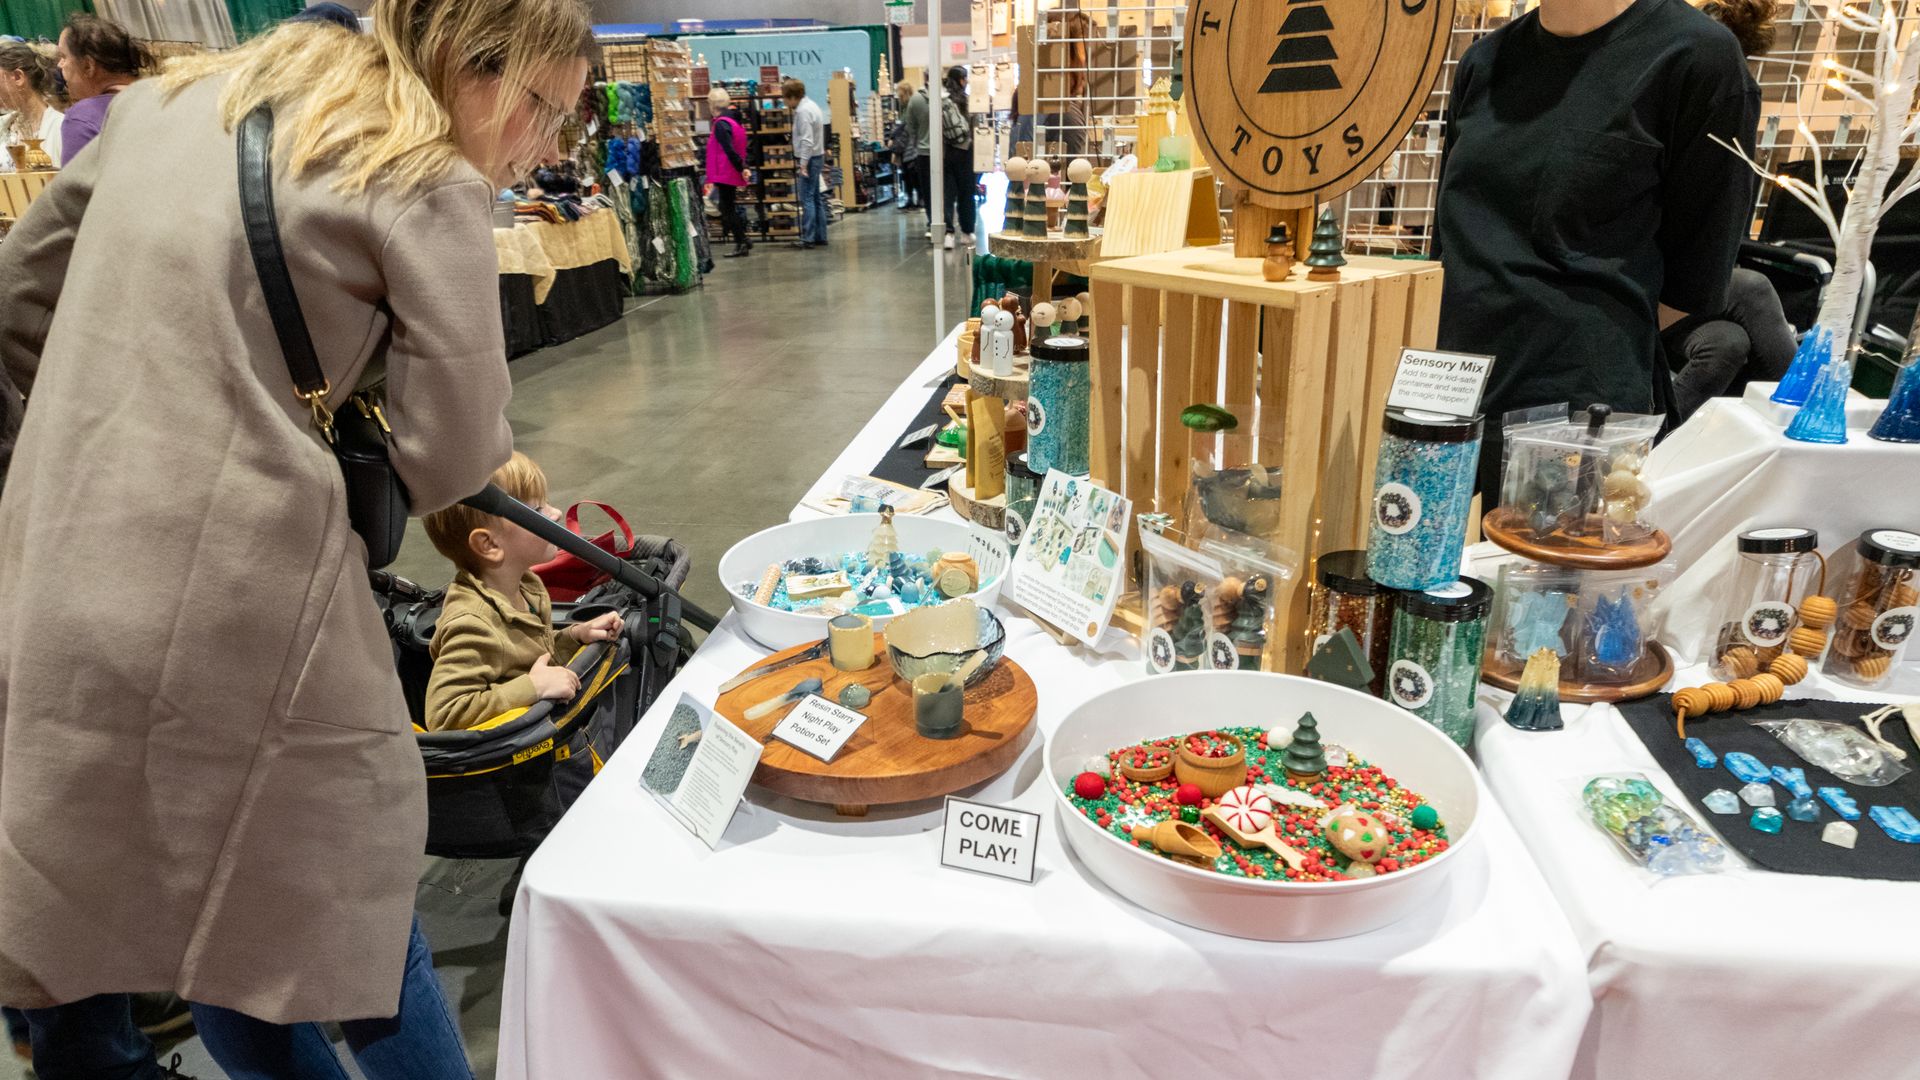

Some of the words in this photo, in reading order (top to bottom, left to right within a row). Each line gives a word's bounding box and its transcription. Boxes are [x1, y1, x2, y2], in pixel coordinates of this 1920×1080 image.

[721, 49, 822, 70] PENDLETON
[1230, 123, 1366, 176] TOYS
[1403, 354, 1456, 372] Sensory
[1459, 360, 1484, 374] Mix
[1397, 378, 1433, 389] container
[1434, 383, 1450, 391] and
[1451, 384, 1475, 394] watch
[1402, 369, 1418, 378] Add
[1420, 370, 1428, 379] to
[1429, 373, 1443, 383] any
[1445, 374, 1478, 384] kid-safe
[1398, 388, 1410, 397] the
[1411, 390, 1435, 400] magic
[801, 711, 823, 726] Night
[823, 720, 841, 735] Play
[809, 699, 831, 713] Resin
[831, 708, 856, 724] Starry
[790, 722, 816, 739] Potion
[815, 734, 831, 746] Set
[960, 811, 1022, 838] COME
[959, 838, 1017, 865] PLAY!
